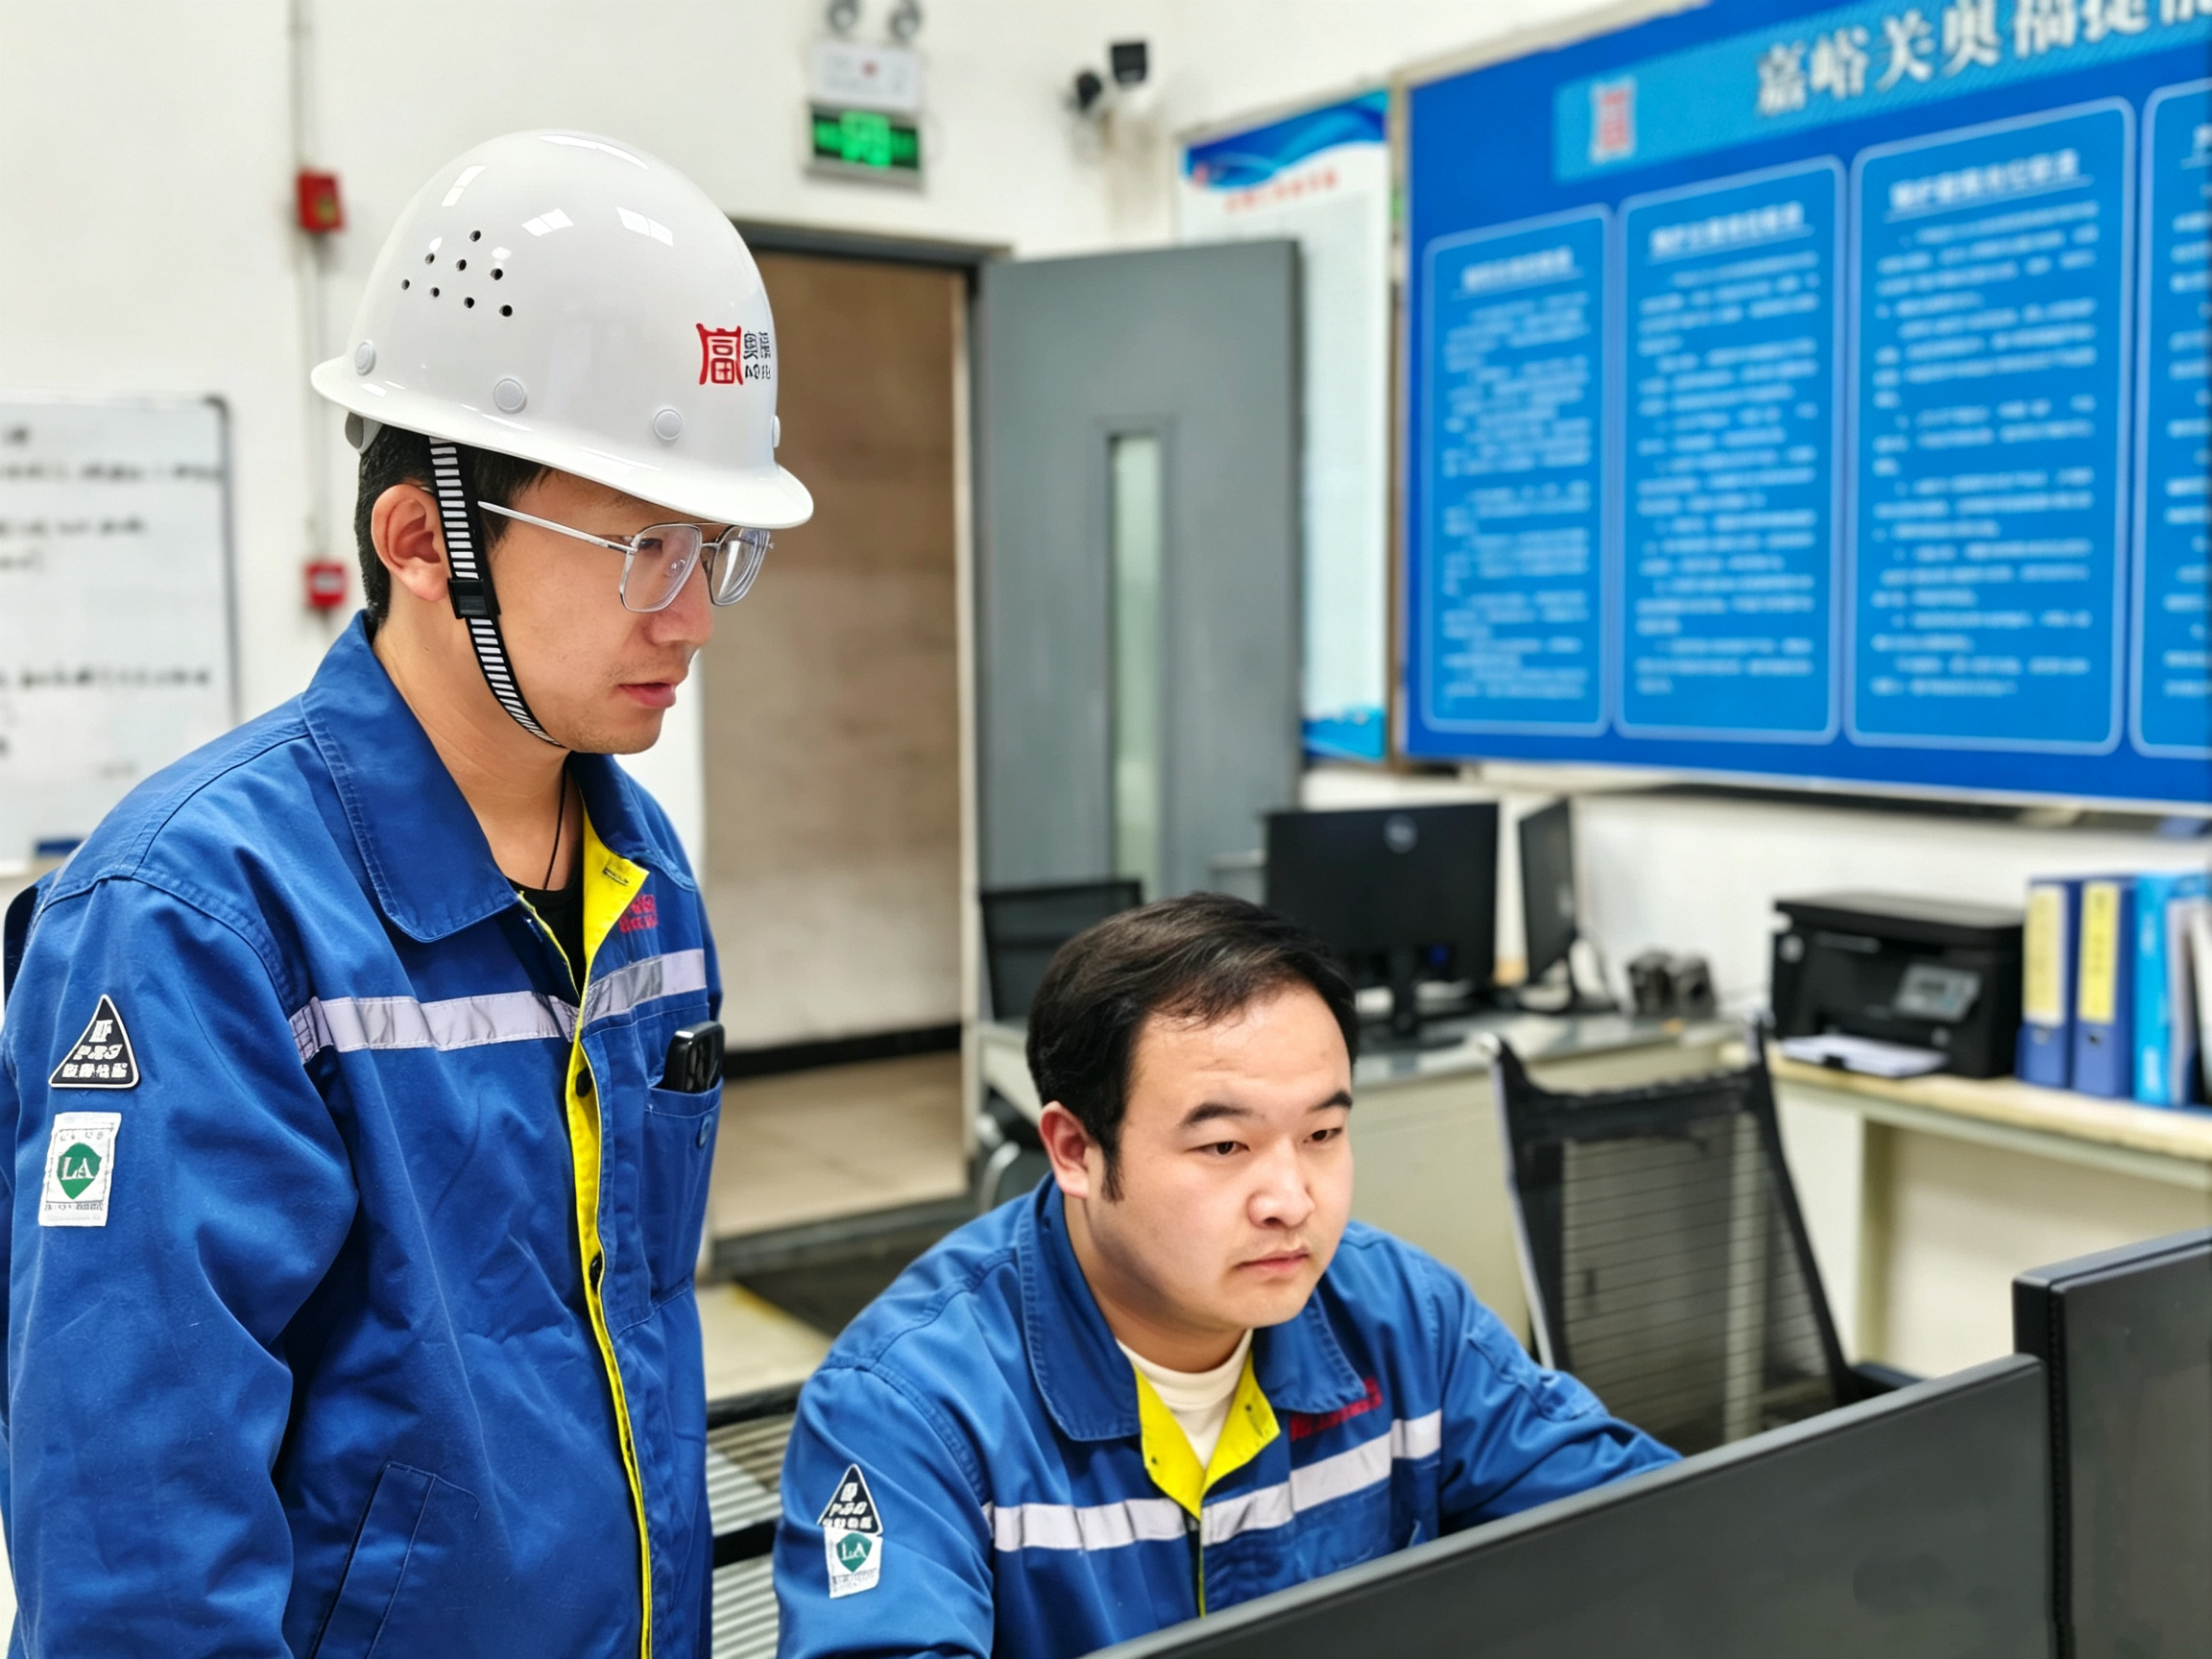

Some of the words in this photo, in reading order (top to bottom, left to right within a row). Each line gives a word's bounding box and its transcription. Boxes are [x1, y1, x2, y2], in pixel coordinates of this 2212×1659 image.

[1756, 0, 2212, 116] 嘉峪关奥福捷
[61, 1157, 94, 1181] LA
[841, 1542, 867, 1561] LA
